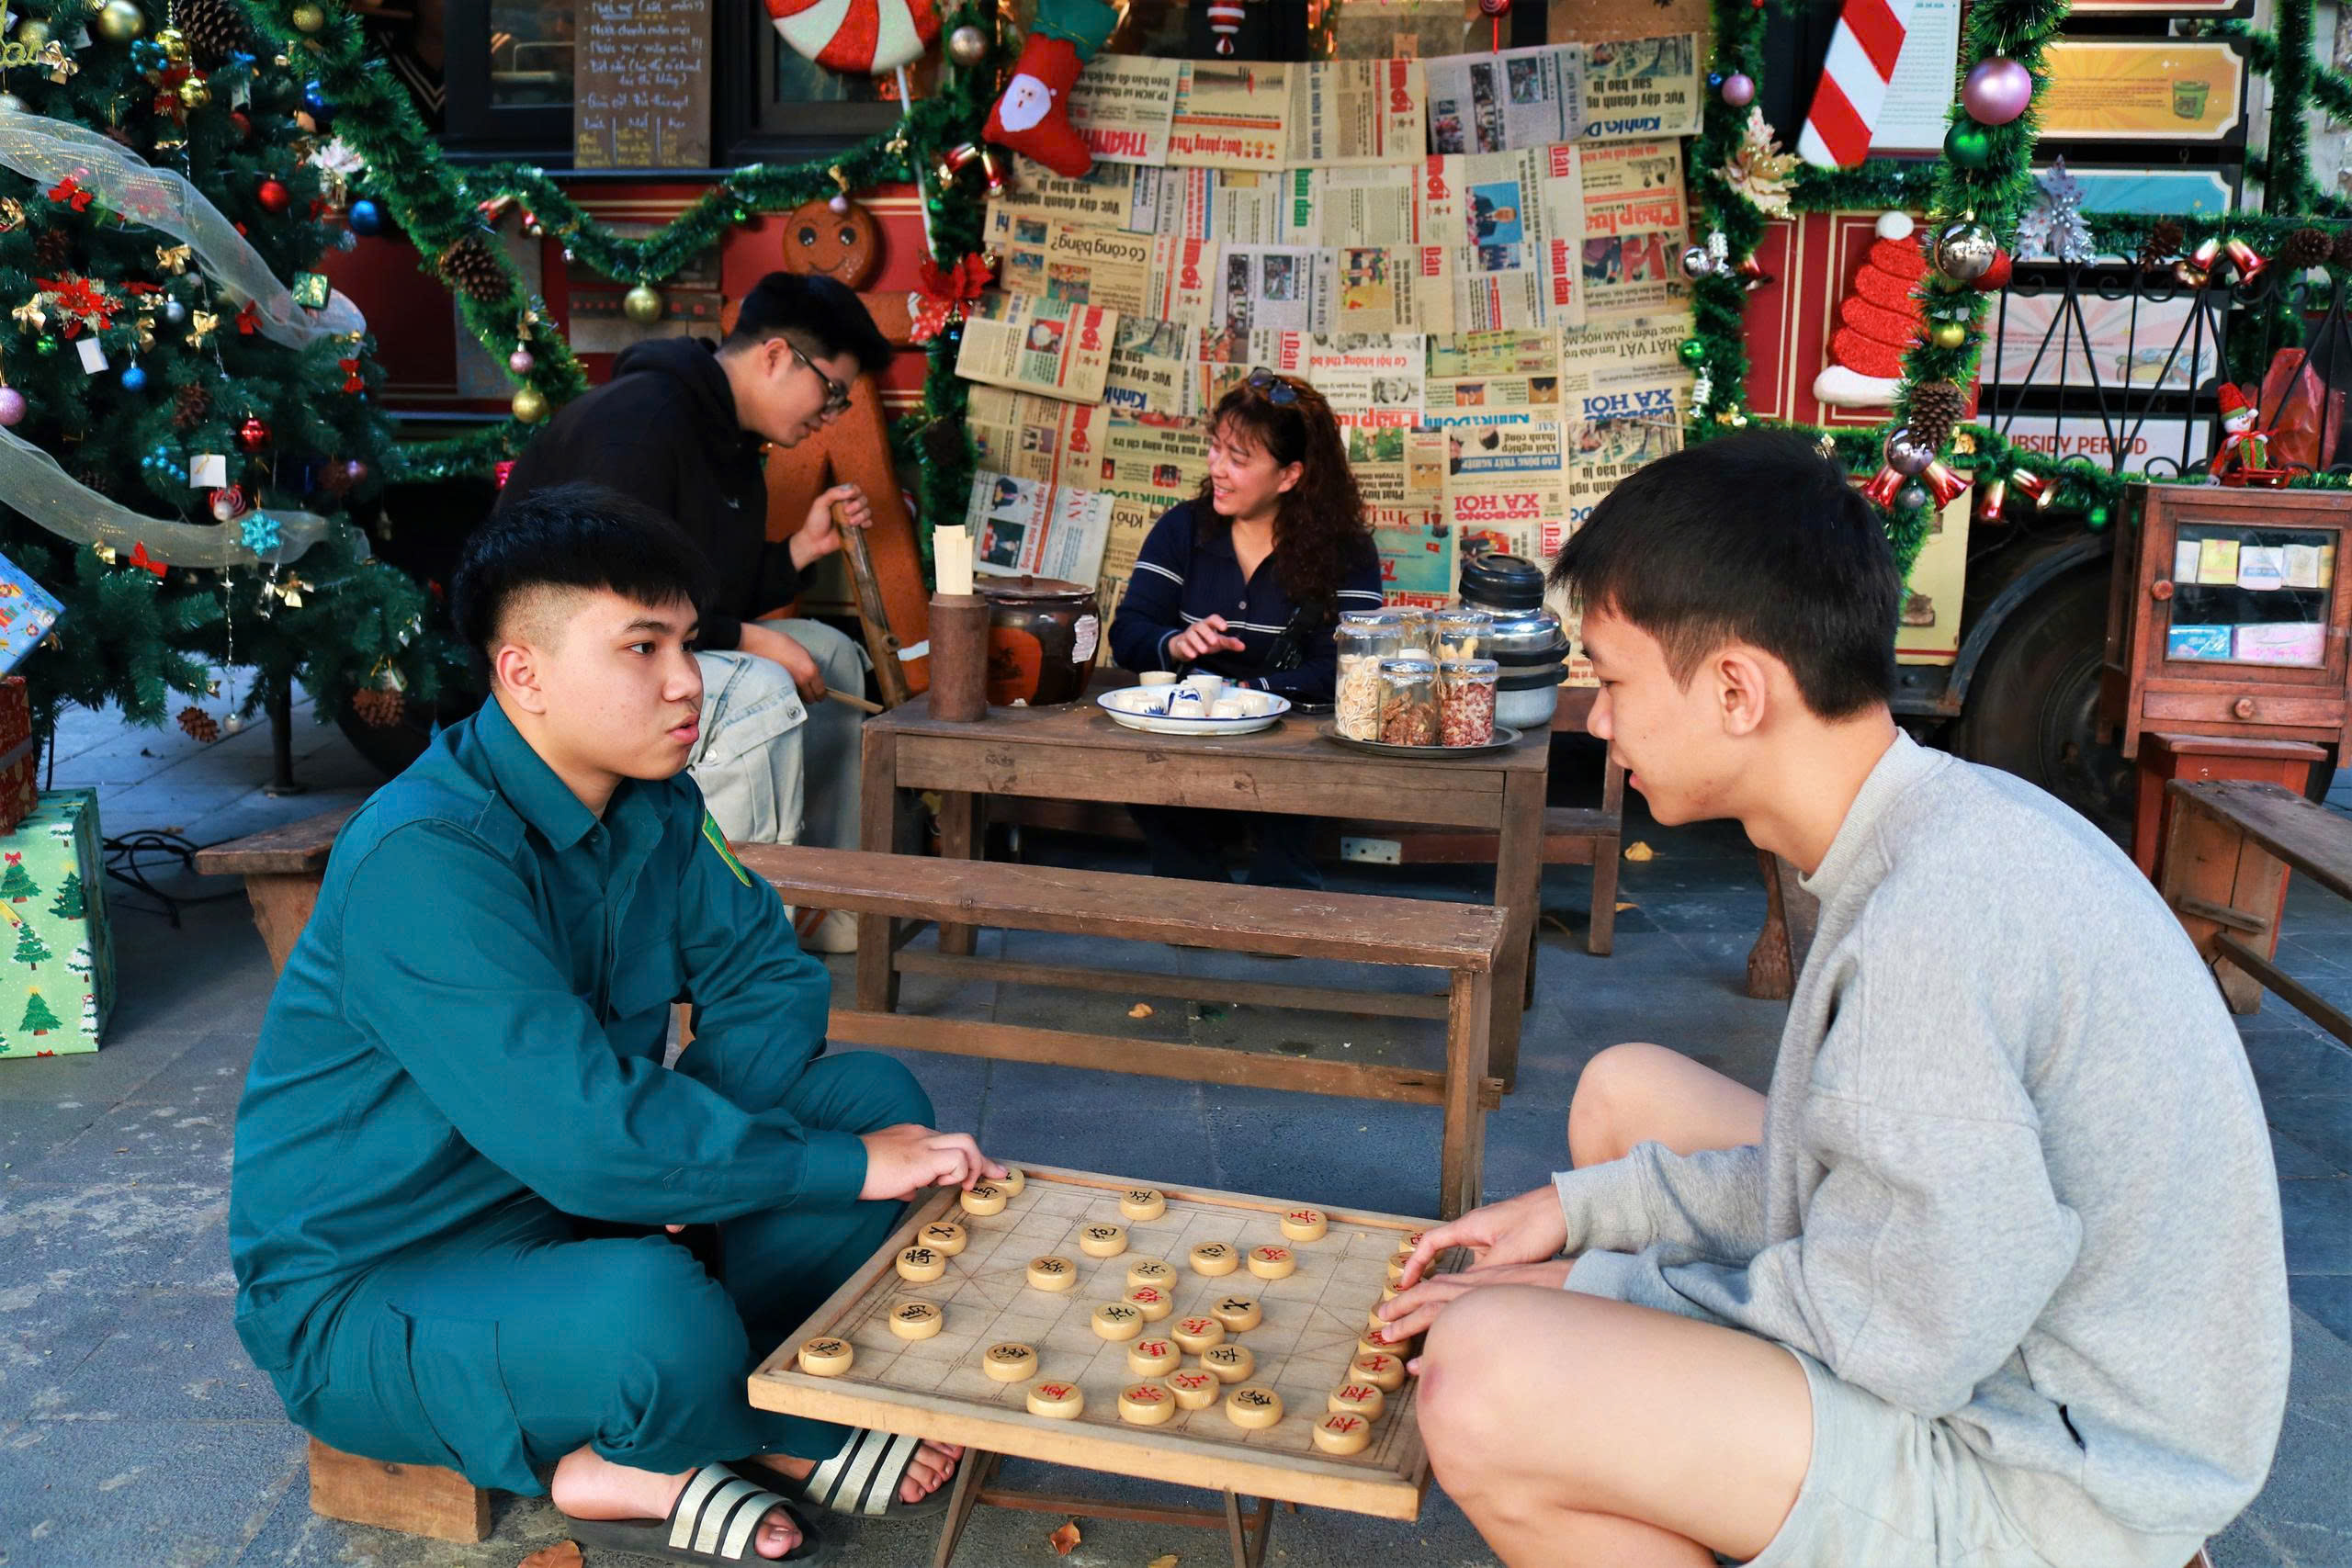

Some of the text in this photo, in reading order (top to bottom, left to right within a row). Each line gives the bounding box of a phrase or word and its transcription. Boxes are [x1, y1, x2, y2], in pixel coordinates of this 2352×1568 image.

[1094, 239, 1127, 260] công
[1130, 247, 1147, 263] Có
[2077, 435, 2148, 456] PEROD
[905, 1249, 937, 1265] 将
